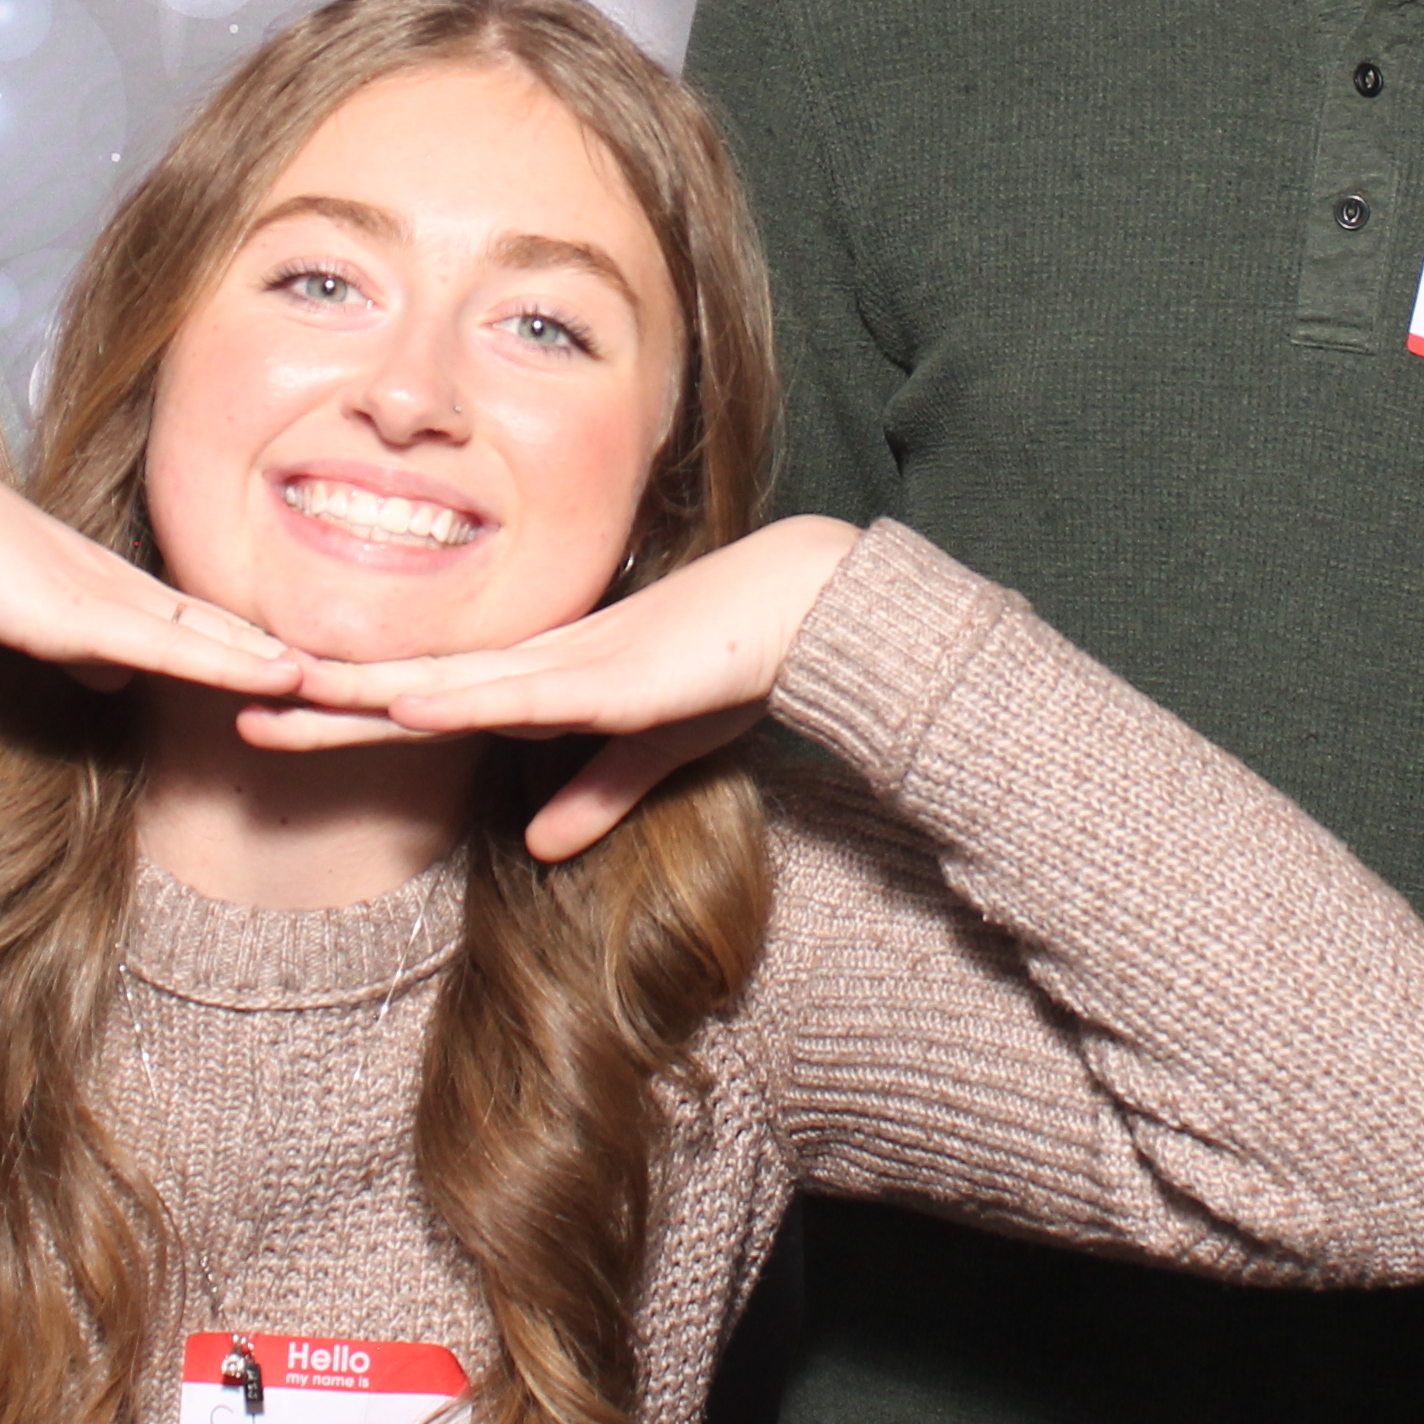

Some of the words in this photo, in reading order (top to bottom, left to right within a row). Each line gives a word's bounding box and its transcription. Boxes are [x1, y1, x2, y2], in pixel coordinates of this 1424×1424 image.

[287, 1341, 371, 1373] Hello
[285, 1373, 309, 1387] my
[312, 1373, 355, 1388] name
[358, 1374, 369, 1389] is
